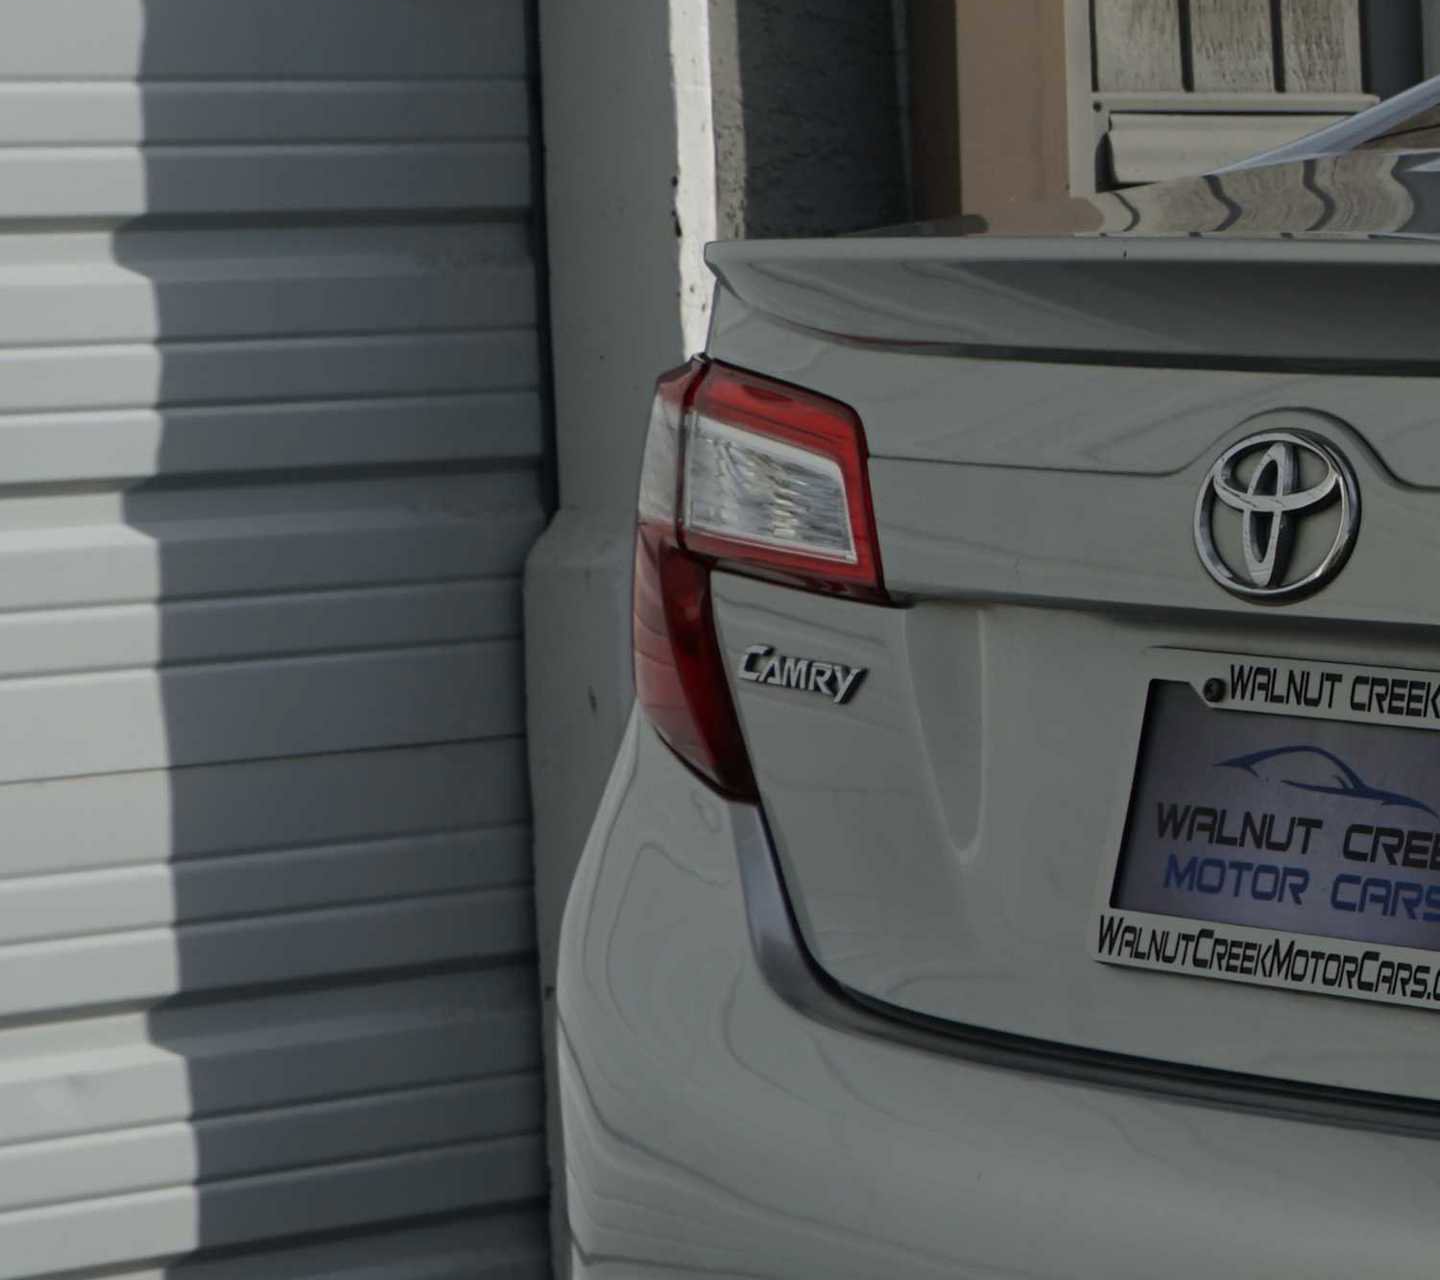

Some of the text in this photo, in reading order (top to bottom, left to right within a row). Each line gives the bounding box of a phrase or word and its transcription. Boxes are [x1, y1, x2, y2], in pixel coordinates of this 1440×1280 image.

[738, 644, 869, 705] CAMRY
[1229, 663, 1342, 709] WALNUT
[1156, 801, 1324, 854] WALNUT
[1162, 853, 1311, 906] MOTOR
